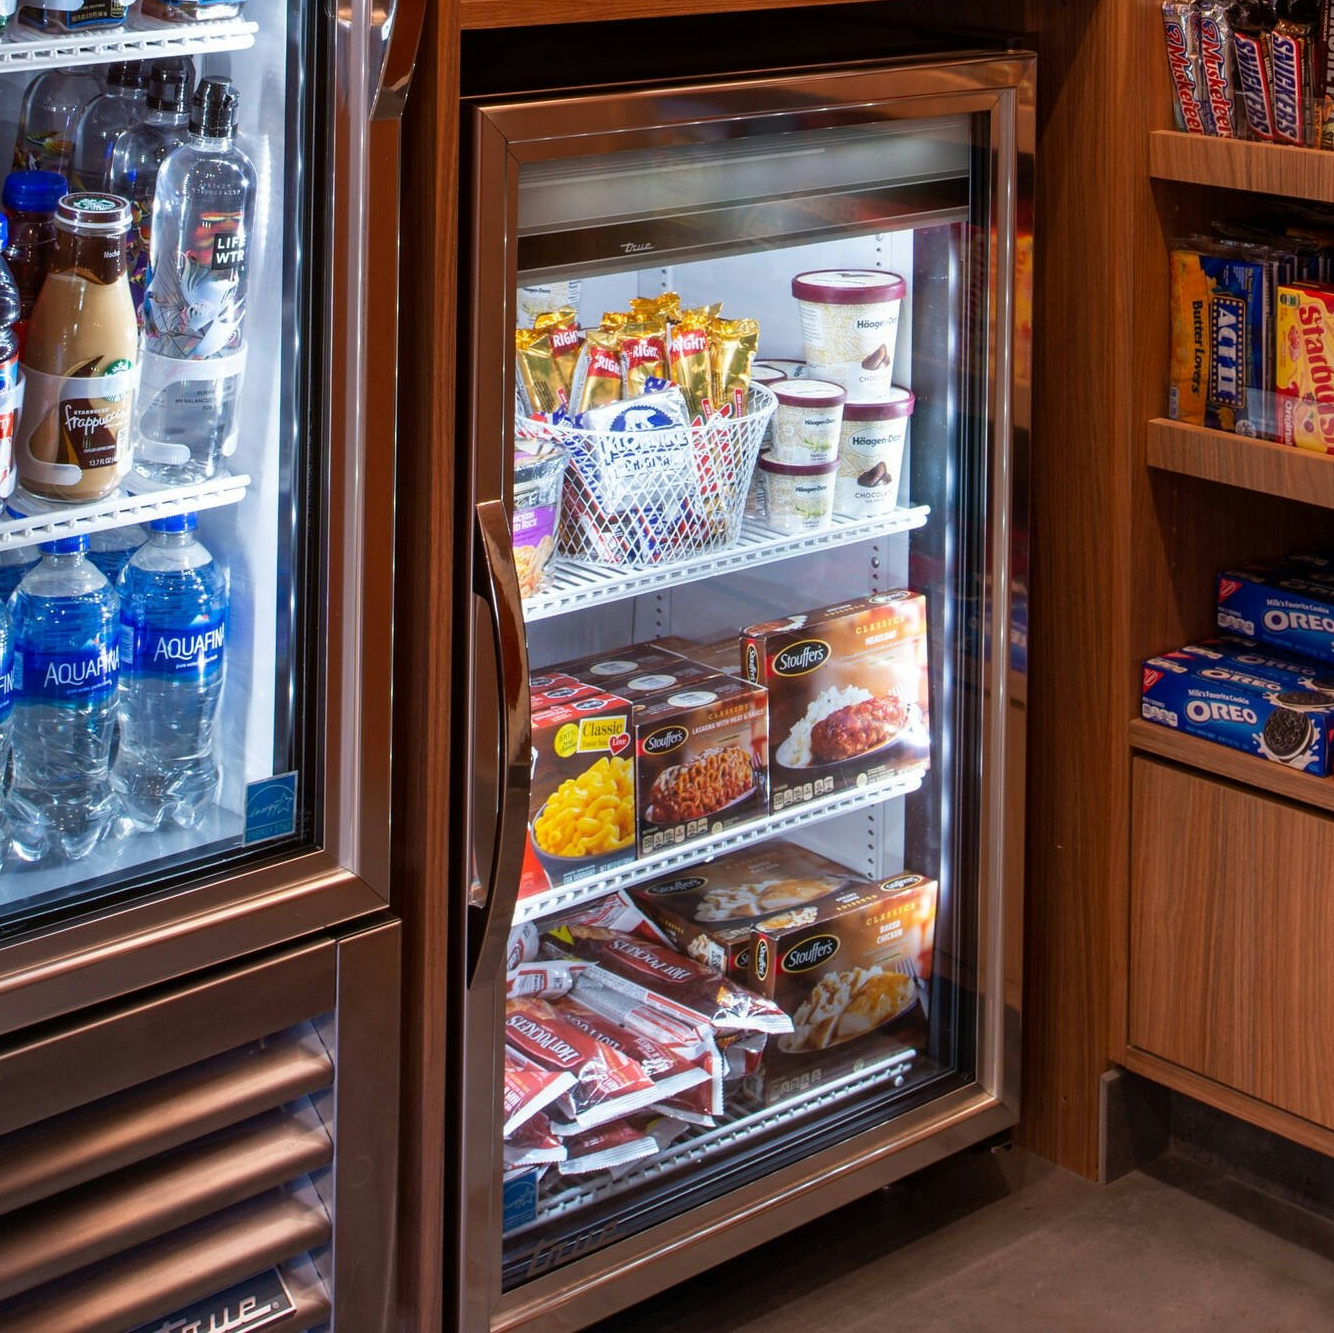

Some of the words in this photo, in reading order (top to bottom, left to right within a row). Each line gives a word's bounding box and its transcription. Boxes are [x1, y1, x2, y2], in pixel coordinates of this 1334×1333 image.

[1201, 19, 1221, 42] 3
[1236, 39, 1268, 136] SNICKERS
[1274, 33, 1297, 139] SNICKERS
[218, 235, 245, 249] LIFE
[620, 241, 655, 253] true
[217, 250, 245, 263] WTR
[1193, 300, 1203, 345] Butter
[1217, 307, 1238, 363] ACT
[672, 335, 705, 351] RIGHT
[1192, 346, 1201, 394] Lovers
[865, 631, 897, 645] MEATLOAF
[44, 647, 120, 687] AQUAFINA
[780, 645, 824, 670] Stouffer's
[693, 723, 715, 735] LASAGNA
[716, 719, 729, 728] WITH
[730, 715, 743, 725] MEAT
[749, 710, 764, 719] SAUCE
[1186, 700, 1258, 725] OREO
[583, 721, 623, 737] Classic
[648, 731, 683, 749] Stouffer's
[880, 920, 901, 933] BAKED
[611, 940, 665, 968] POCKETS
[789, 940, 833, 967] Stouffer's
[506, 1015, 552, 1050] POCKETS
[549, 1041, 581, 1063] HOT
